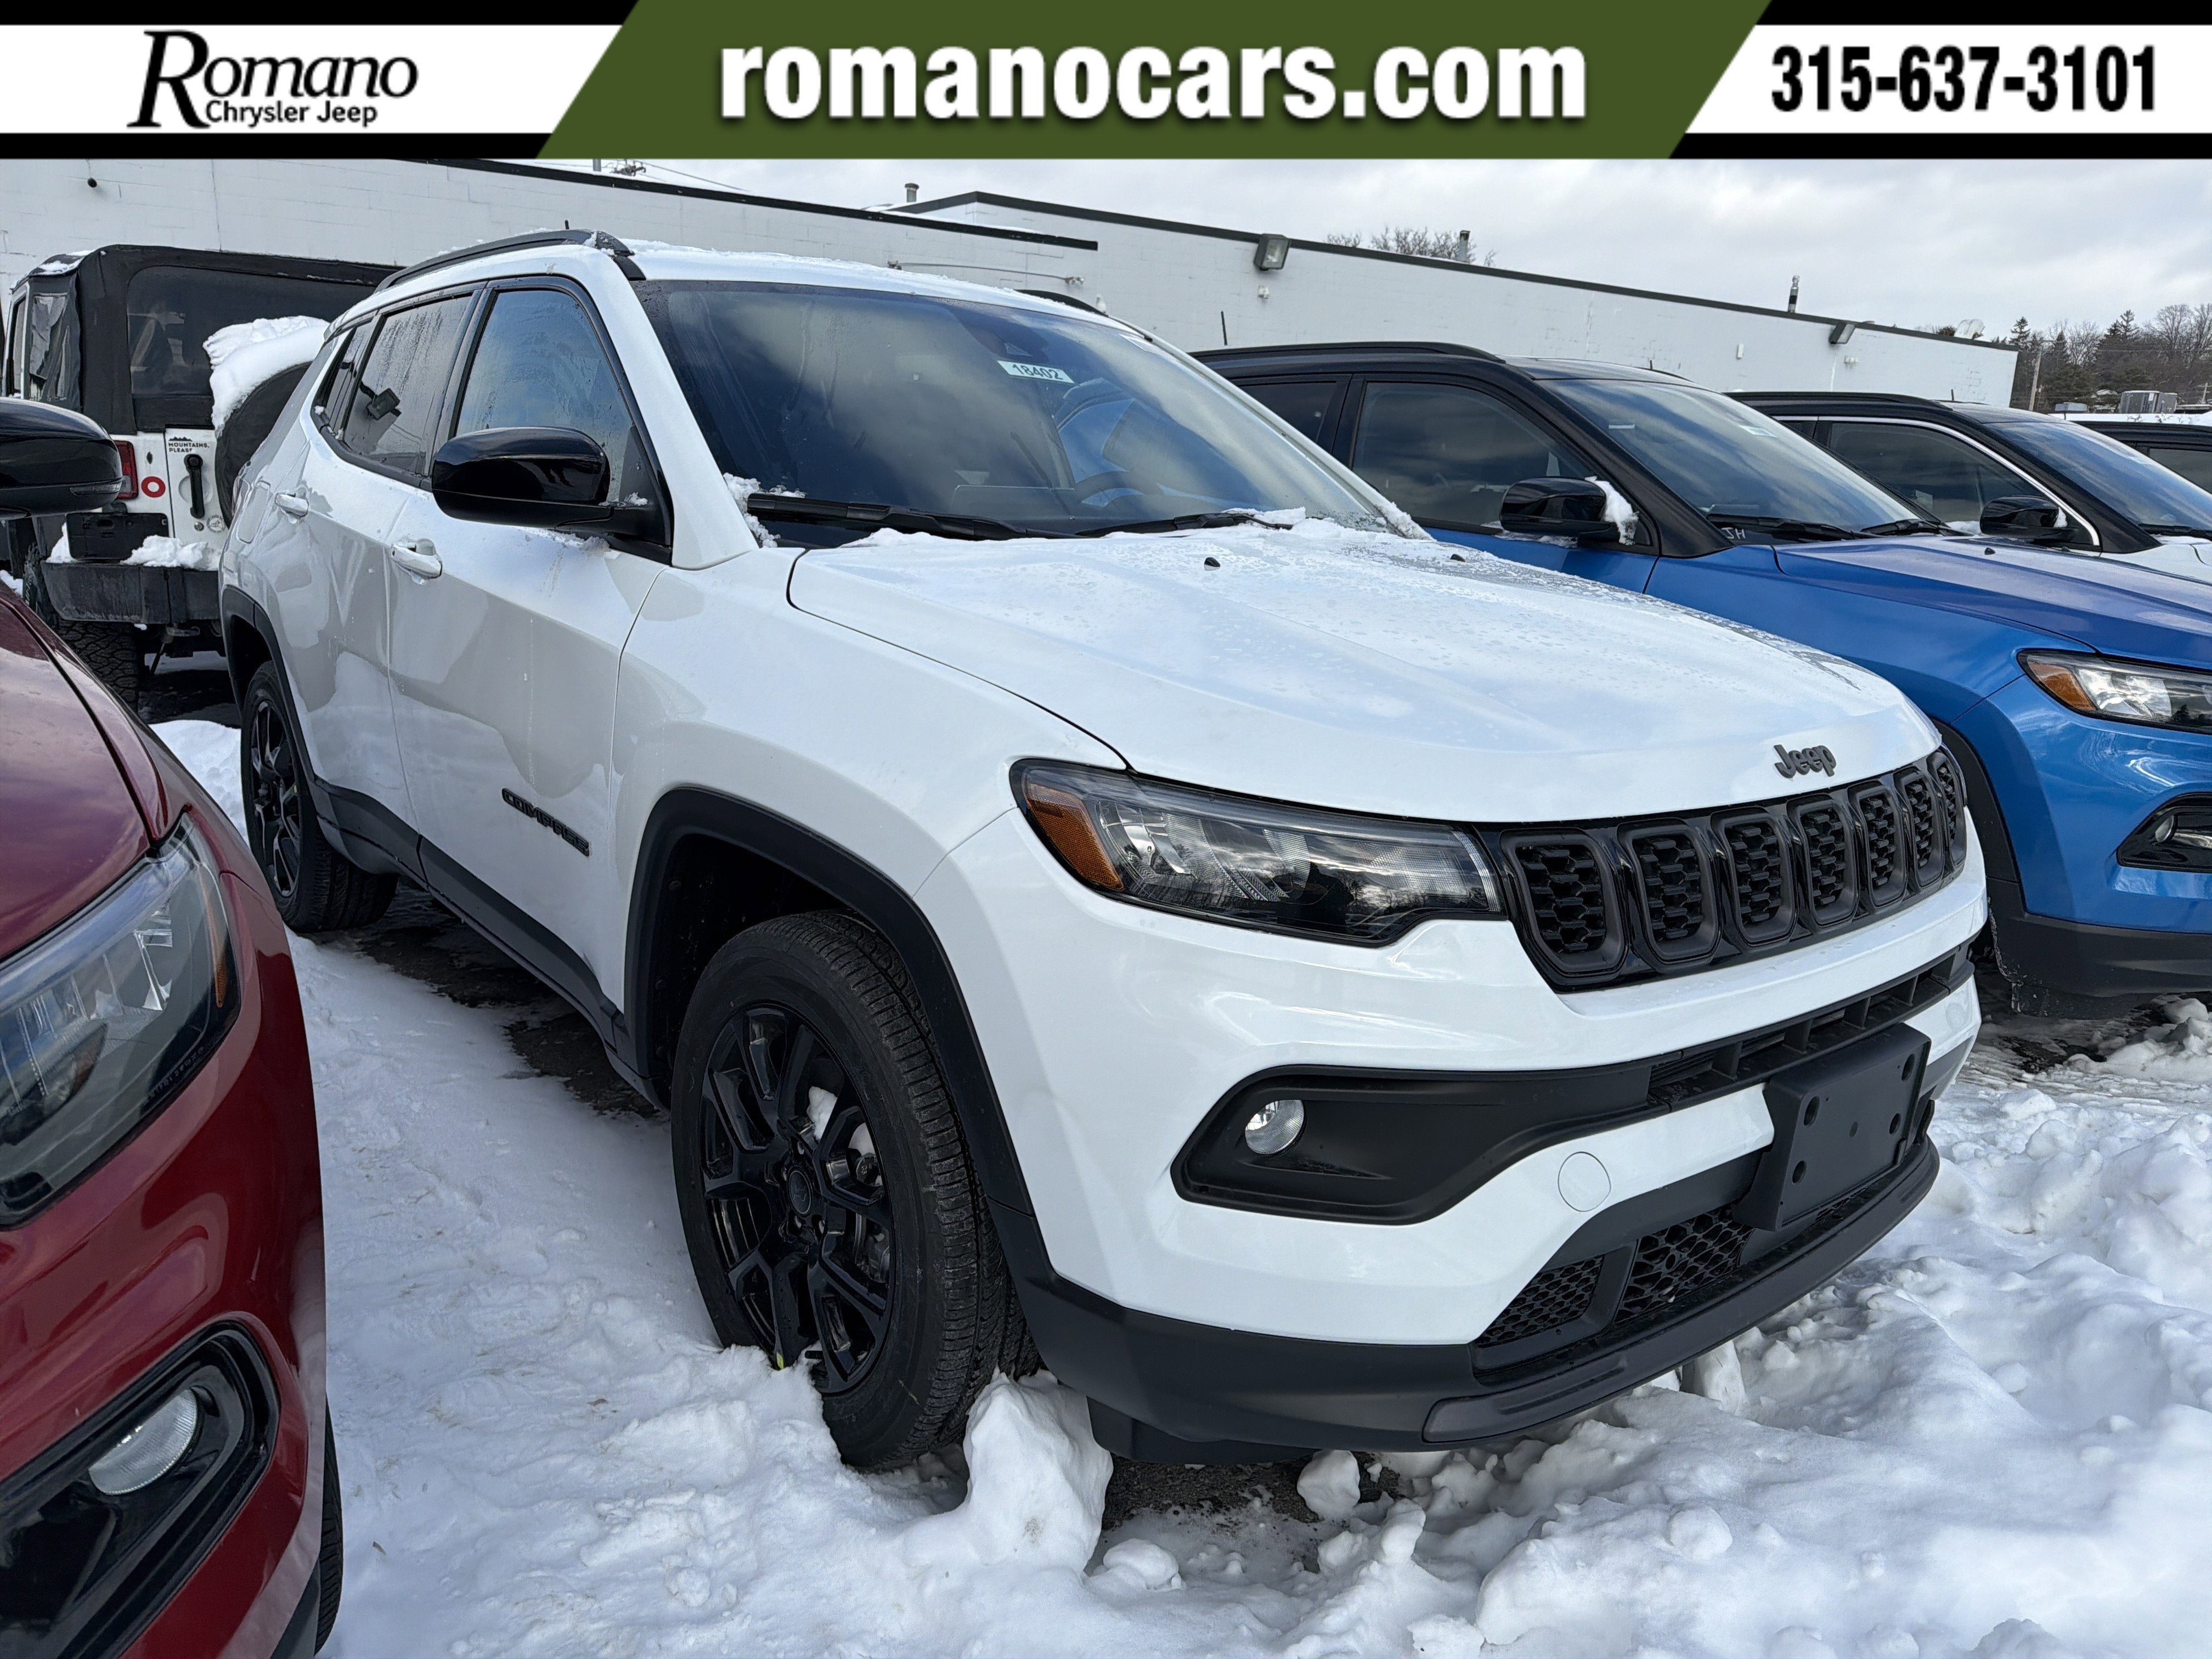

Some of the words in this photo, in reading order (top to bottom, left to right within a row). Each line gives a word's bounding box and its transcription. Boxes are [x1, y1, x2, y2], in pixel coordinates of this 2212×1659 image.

[1012, 364, 1064, 380] 18402
[1773, 744, 1837, 778] Jeep
[501, 788, 590, 857] COMPASS
